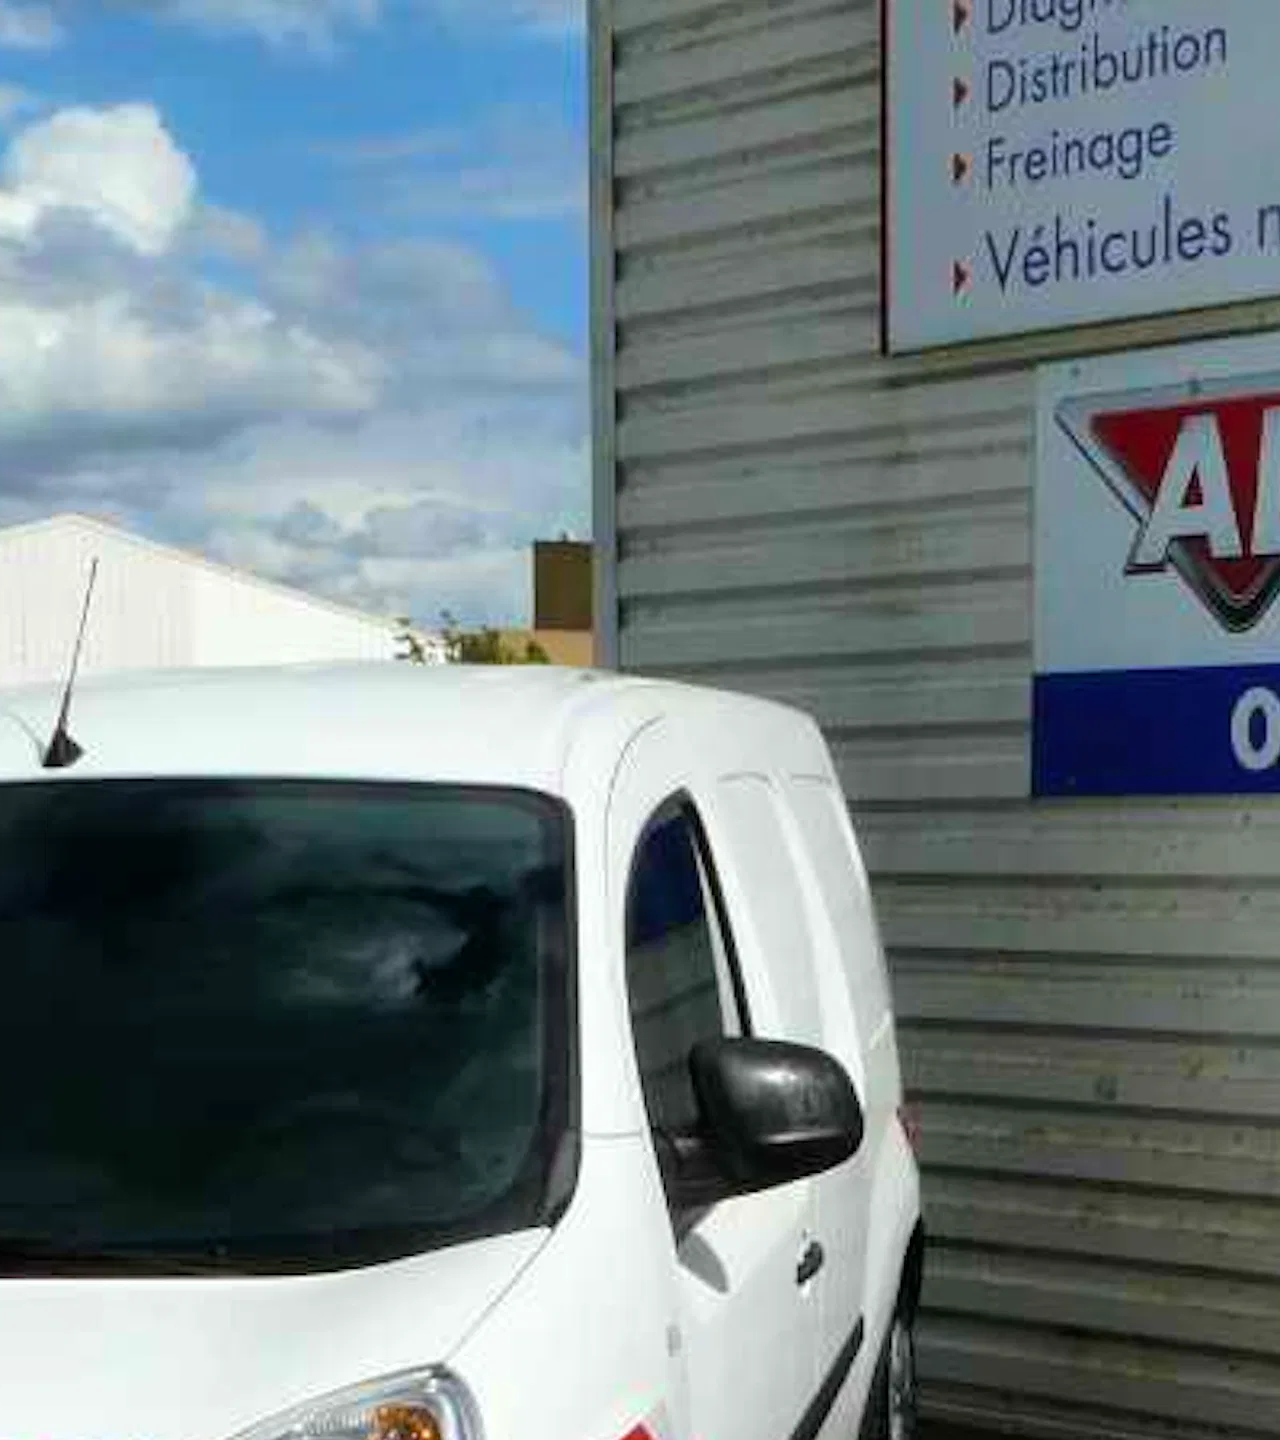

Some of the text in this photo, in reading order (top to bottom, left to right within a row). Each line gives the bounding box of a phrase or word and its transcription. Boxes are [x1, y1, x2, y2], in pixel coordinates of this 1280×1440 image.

[987, 0, 1112, 34] Diag
[987, 25, 1227, 112] Distribution
[987, 118, 1174, 191] Freinage
[987, 194, 1232, 293] Véhicules
